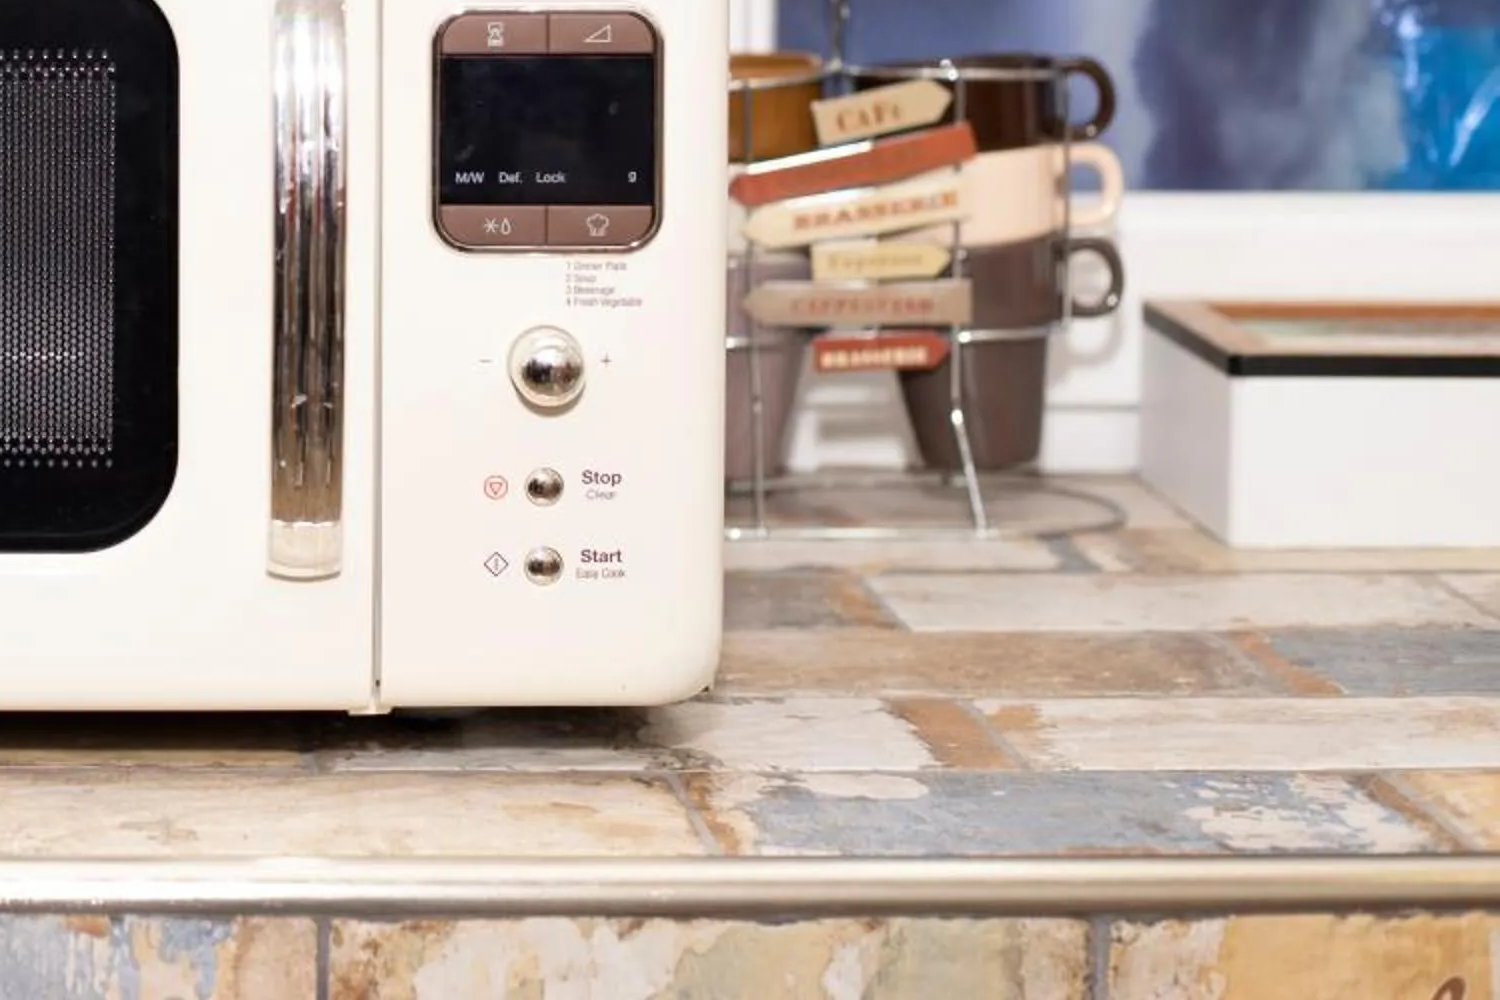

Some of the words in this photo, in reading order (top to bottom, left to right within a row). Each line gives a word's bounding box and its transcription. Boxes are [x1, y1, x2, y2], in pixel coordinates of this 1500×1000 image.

[455, 171, 485, 184] M/W
[499, 171, 523, 184] Def.
[535, 171, 567, 184] Lock
[580, 469, 623, 487] Stop
[580, 548, 623, 564] Start
